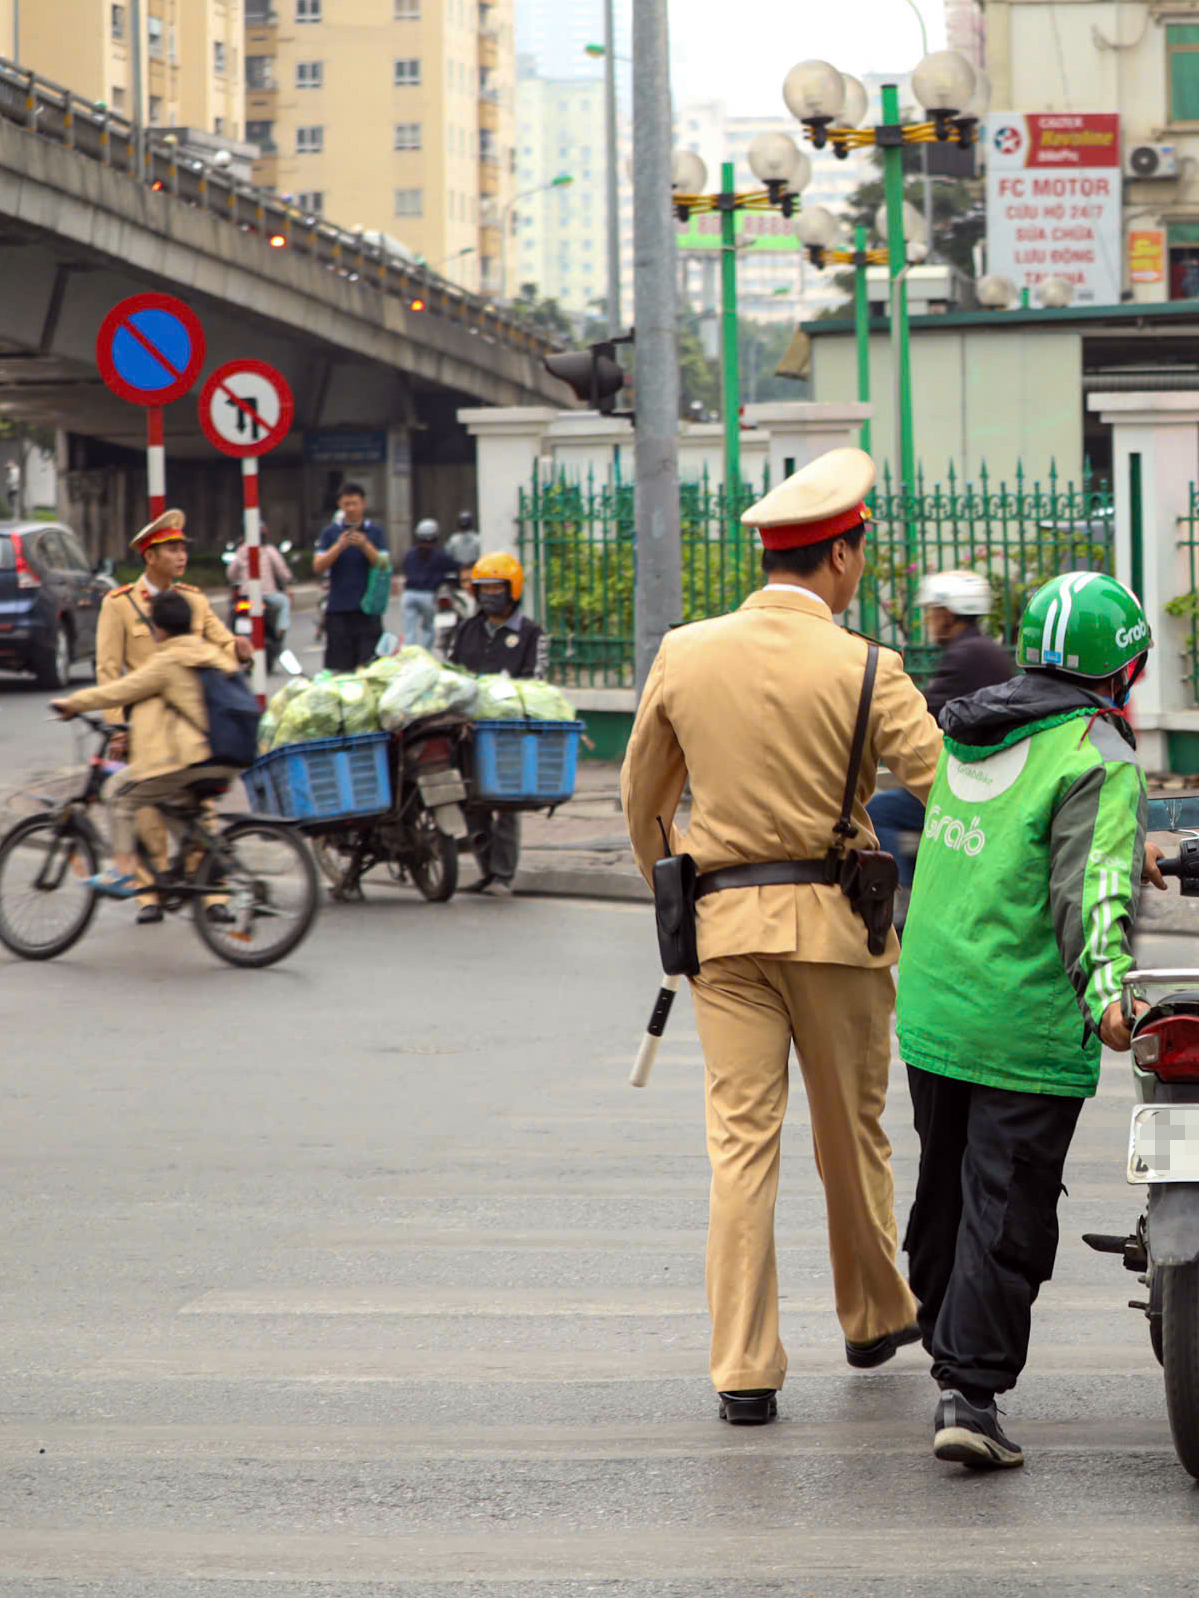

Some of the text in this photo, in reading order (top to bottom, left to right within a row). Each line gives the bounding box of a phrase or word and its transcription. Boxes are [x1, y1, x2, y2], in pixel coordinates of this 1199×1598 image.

[999, 178, 1111, 198] FC MOTOR
[1115, 617, 1147, 648] Grab
[924, 805, 986, 857] Grab
